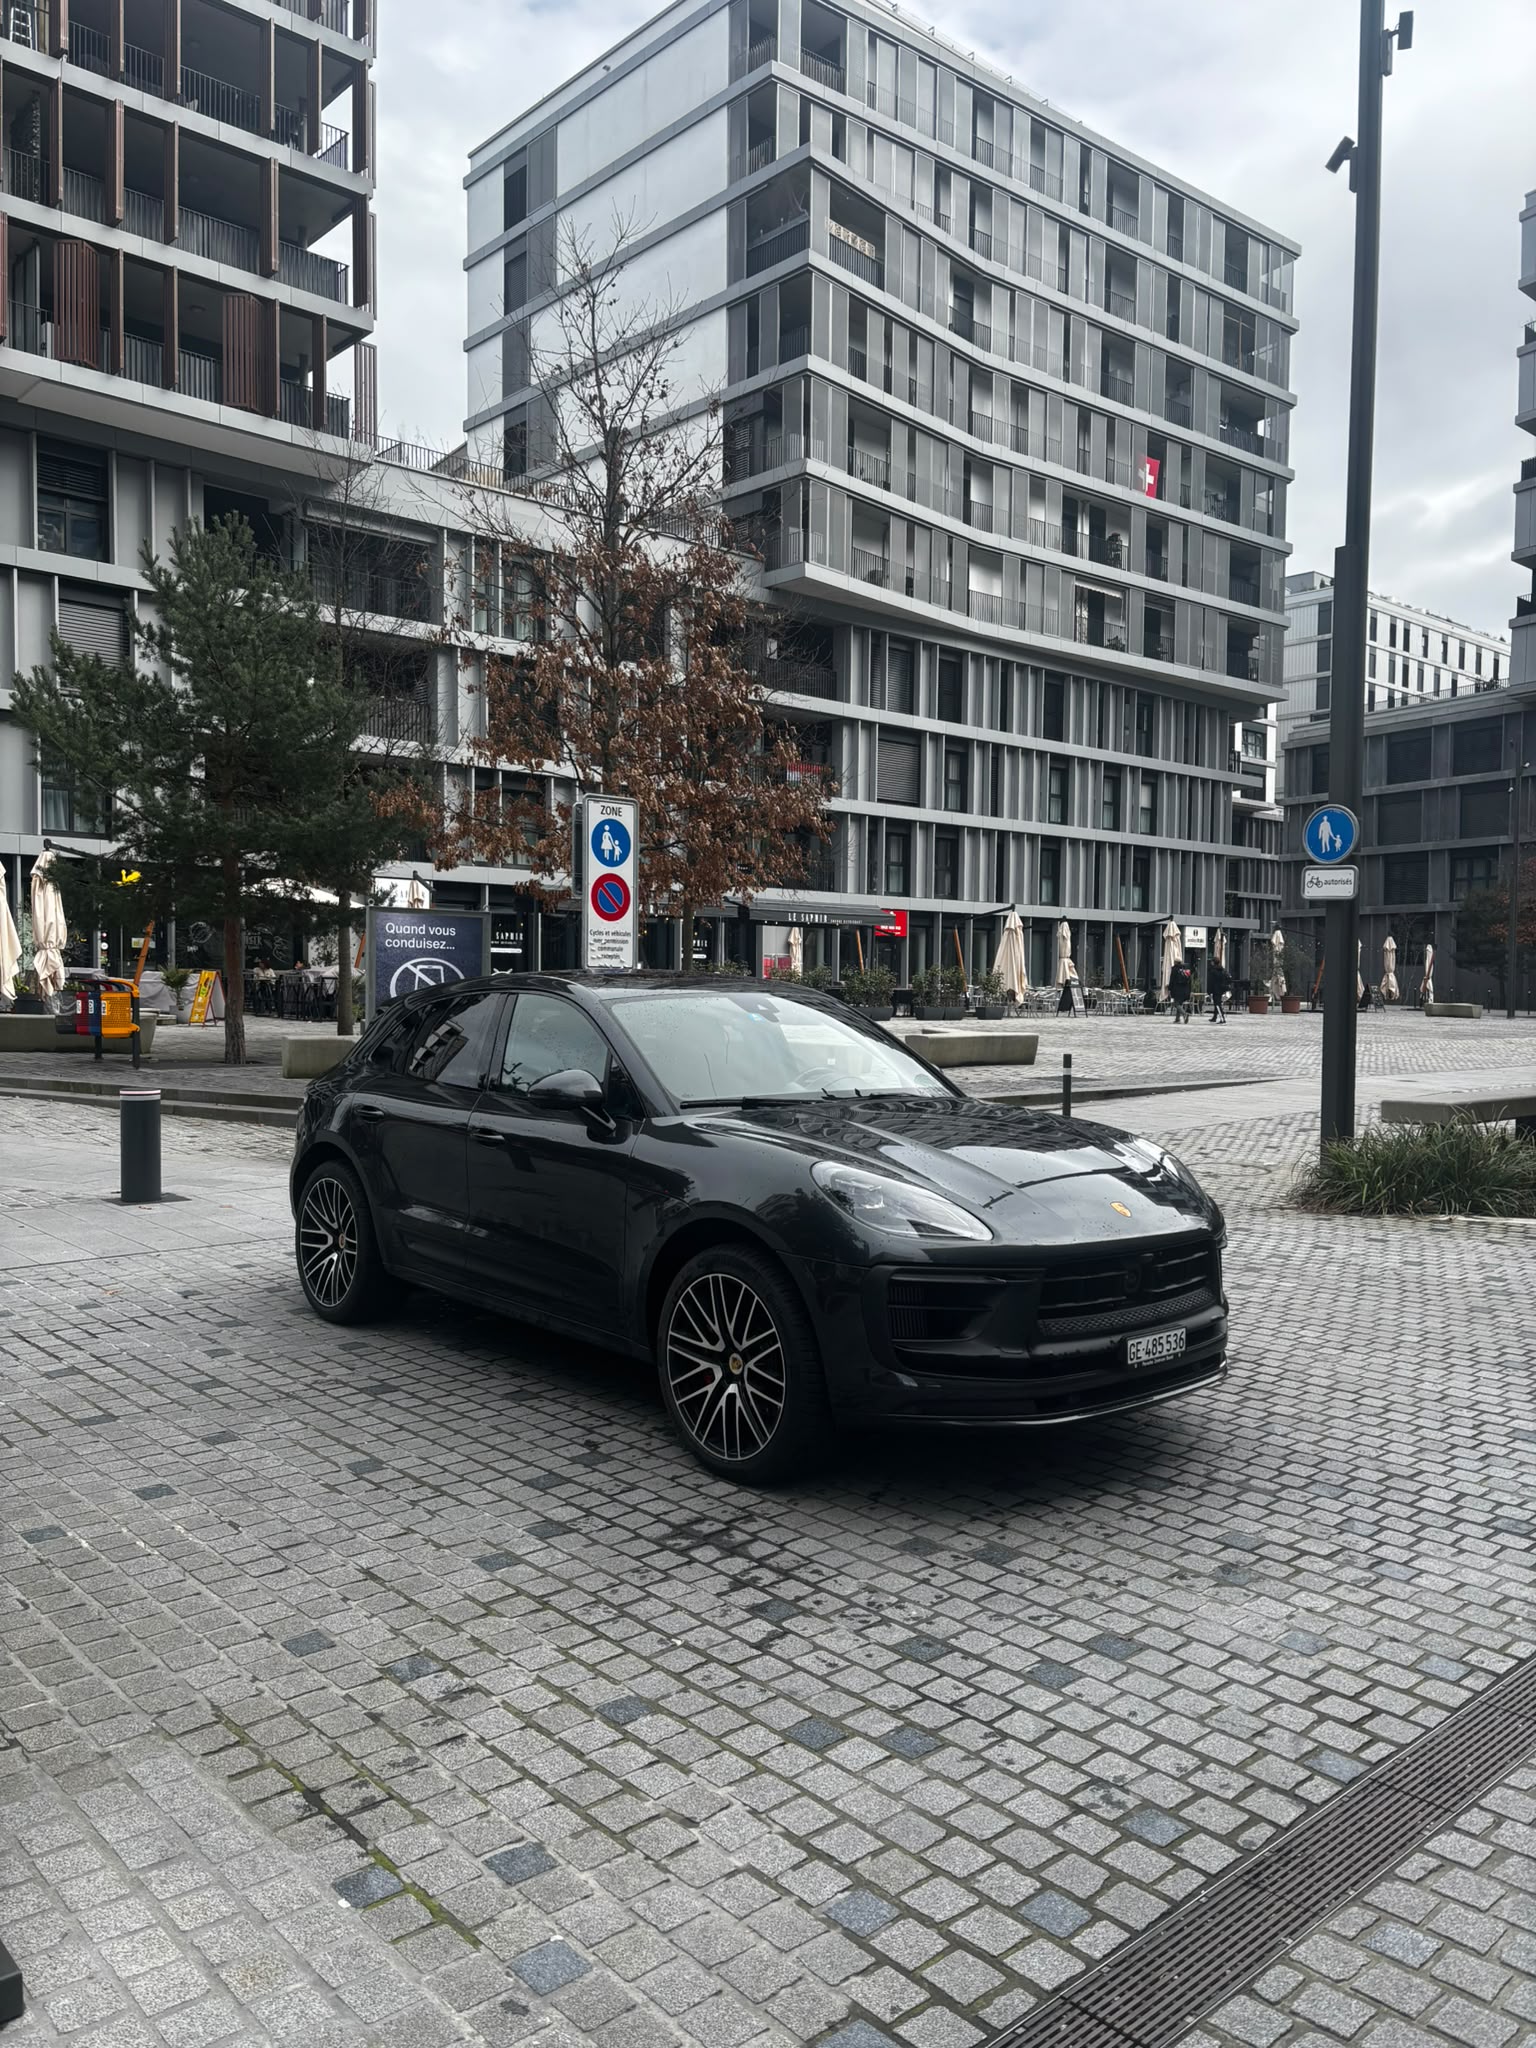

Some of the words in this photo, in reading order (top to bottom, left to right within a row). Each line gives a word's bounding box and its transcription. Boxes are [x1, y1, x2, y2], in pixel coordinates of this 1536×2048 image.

[600, 804, 622, 817] ZONE
[1323, 877, 1353, 886] autorisés
[385, 922, 426, 935] Quand
[429, 926, 456, 936] vous
[589, 929, 604, 937] Cycles
